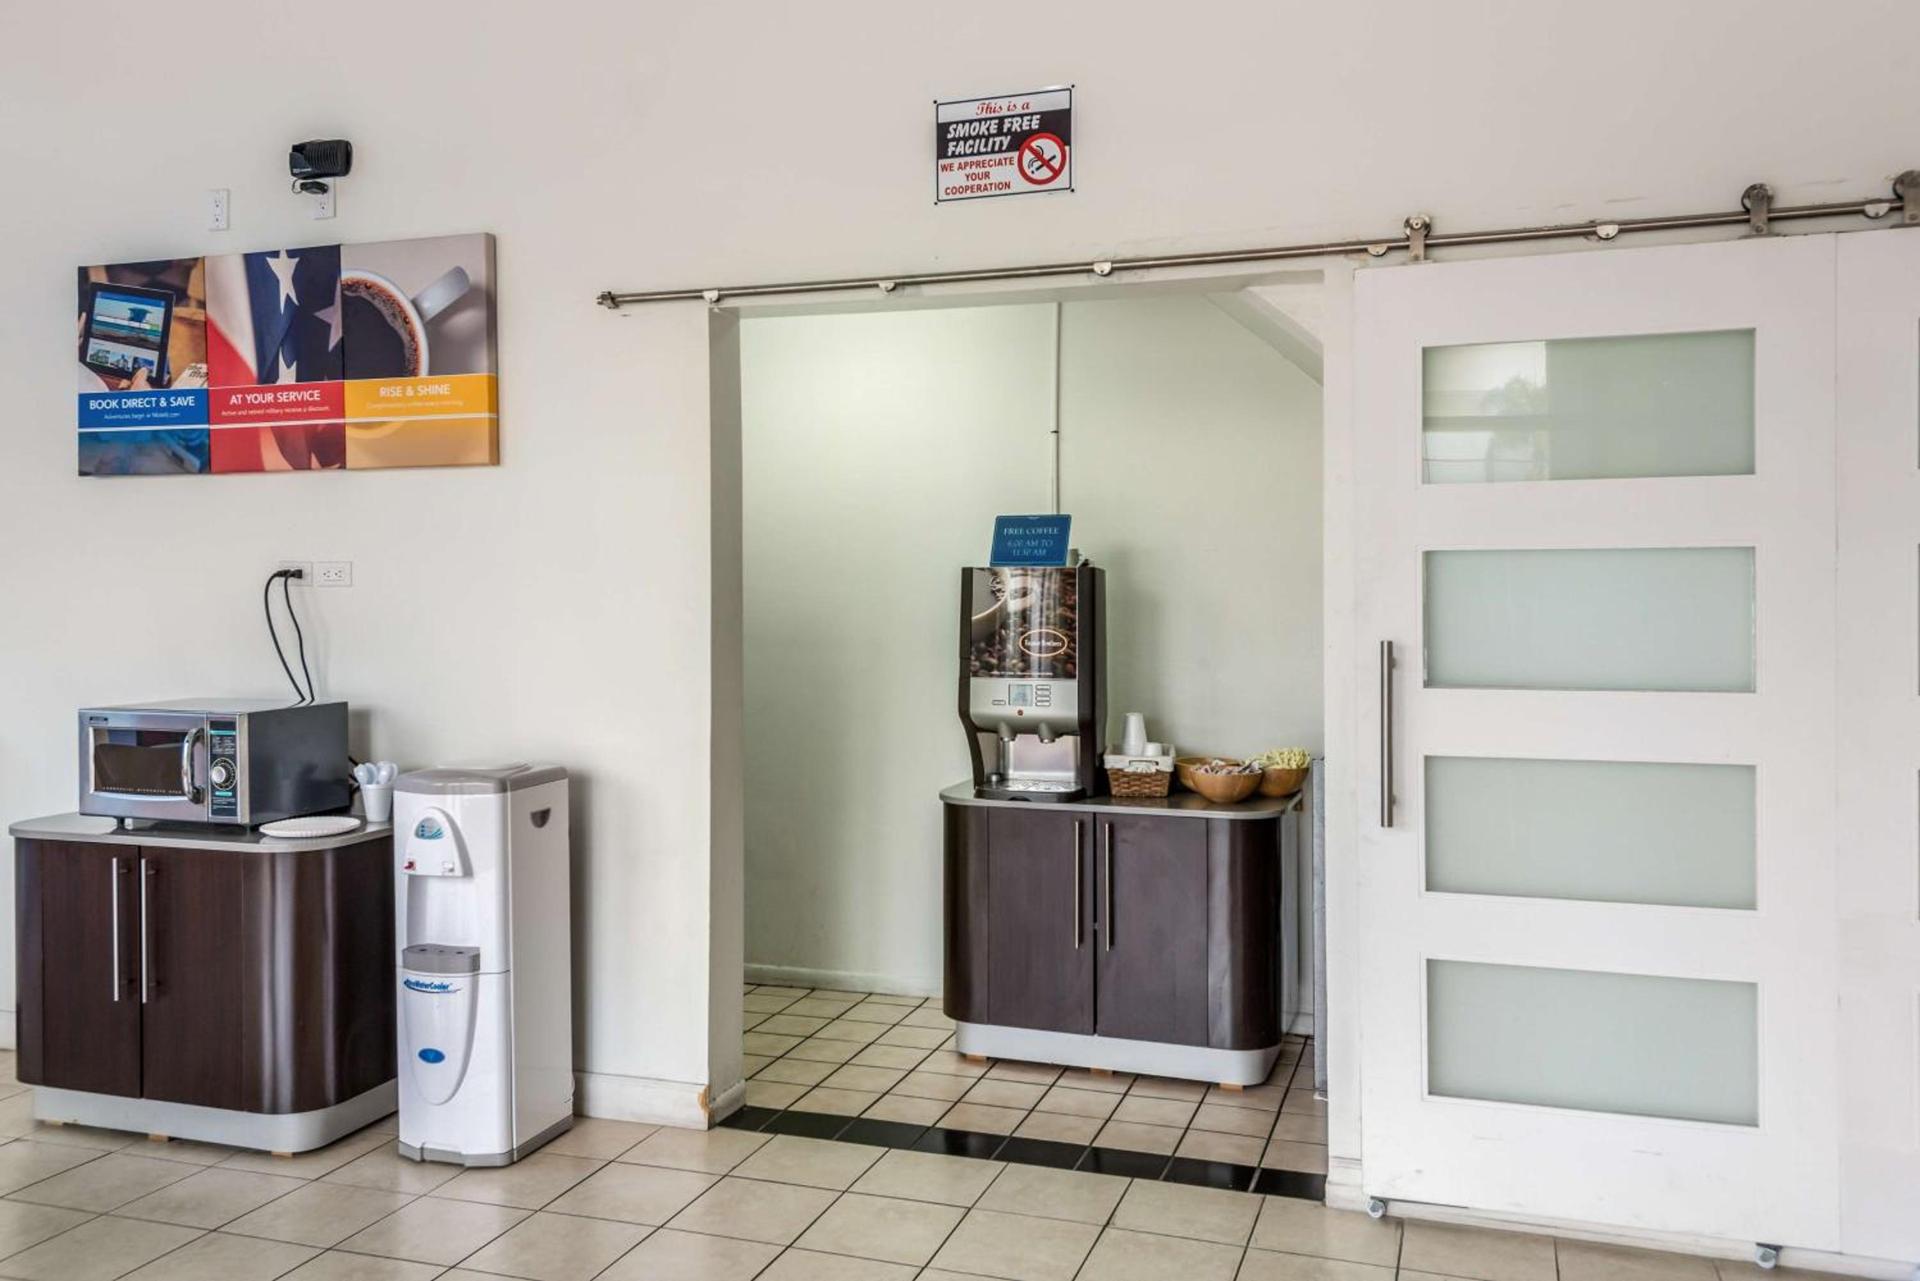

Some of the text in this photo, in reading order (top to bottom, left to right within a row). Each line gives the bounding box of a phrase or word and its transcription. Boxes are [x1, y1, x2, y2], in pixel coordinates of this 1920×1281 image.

[976, 101, 1031, 116] This is a
[947, 114, 1041, 138] SMOKE FREE
[946, 136, 1011, 156] FACILITY
[940, 156, 1015, 172] WE APPRECIATE
[965, 171, 990, 182] YOUR
[944, 182, 1011, 196] COOPERATION
[230, 390, 320, 405] AT YOUR SERVICE
[380, 384, 451, 397] RISE & SHINE
[89, 396, 196, 410] BOOK DIRECT & SAVE
[1004, 527, 1060, 536] FREE COFFEE
